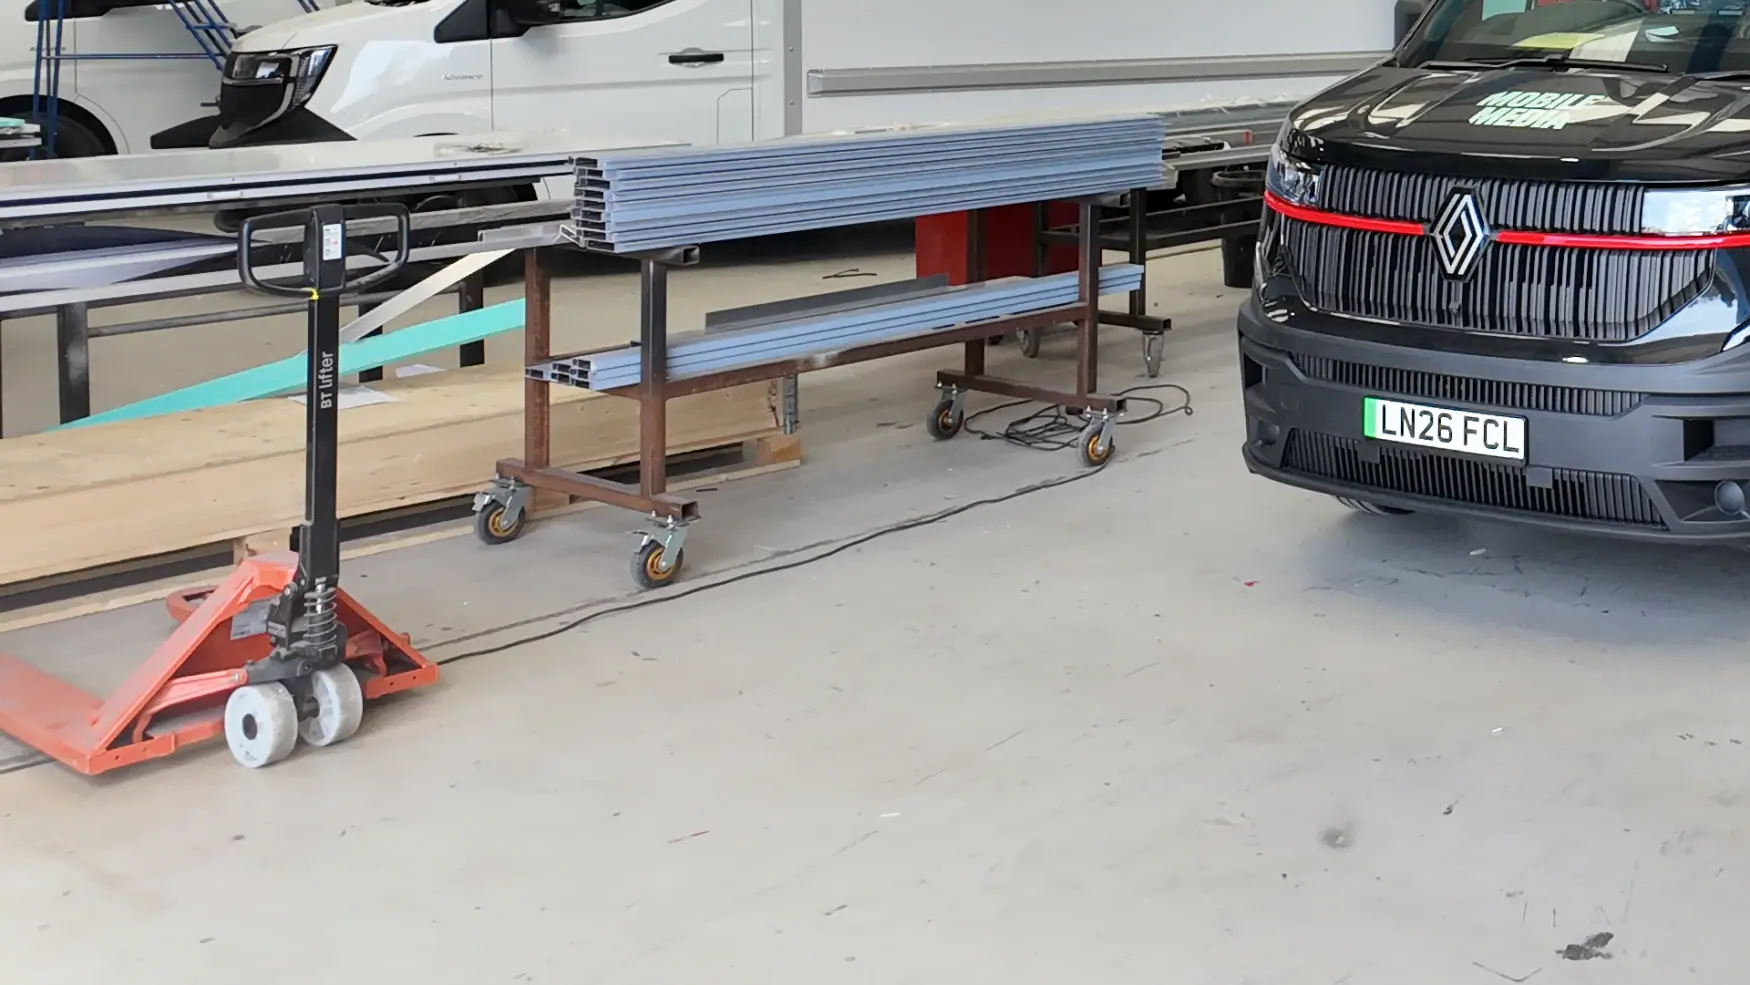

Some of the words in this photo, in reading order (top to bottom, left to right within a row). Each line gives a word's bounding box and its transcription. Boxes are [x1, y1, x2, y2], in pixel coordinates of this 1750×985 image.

[1476, 91, 1606, 110] MOBILE
[1468, 106, 1571, 130] MEDIA
[318, 351, 334, 390] lifter
[320, 391, 333, 409] BT
[1382, 404, 1453, 443] LN26
[1463, 415, 1520, 453] FCL
